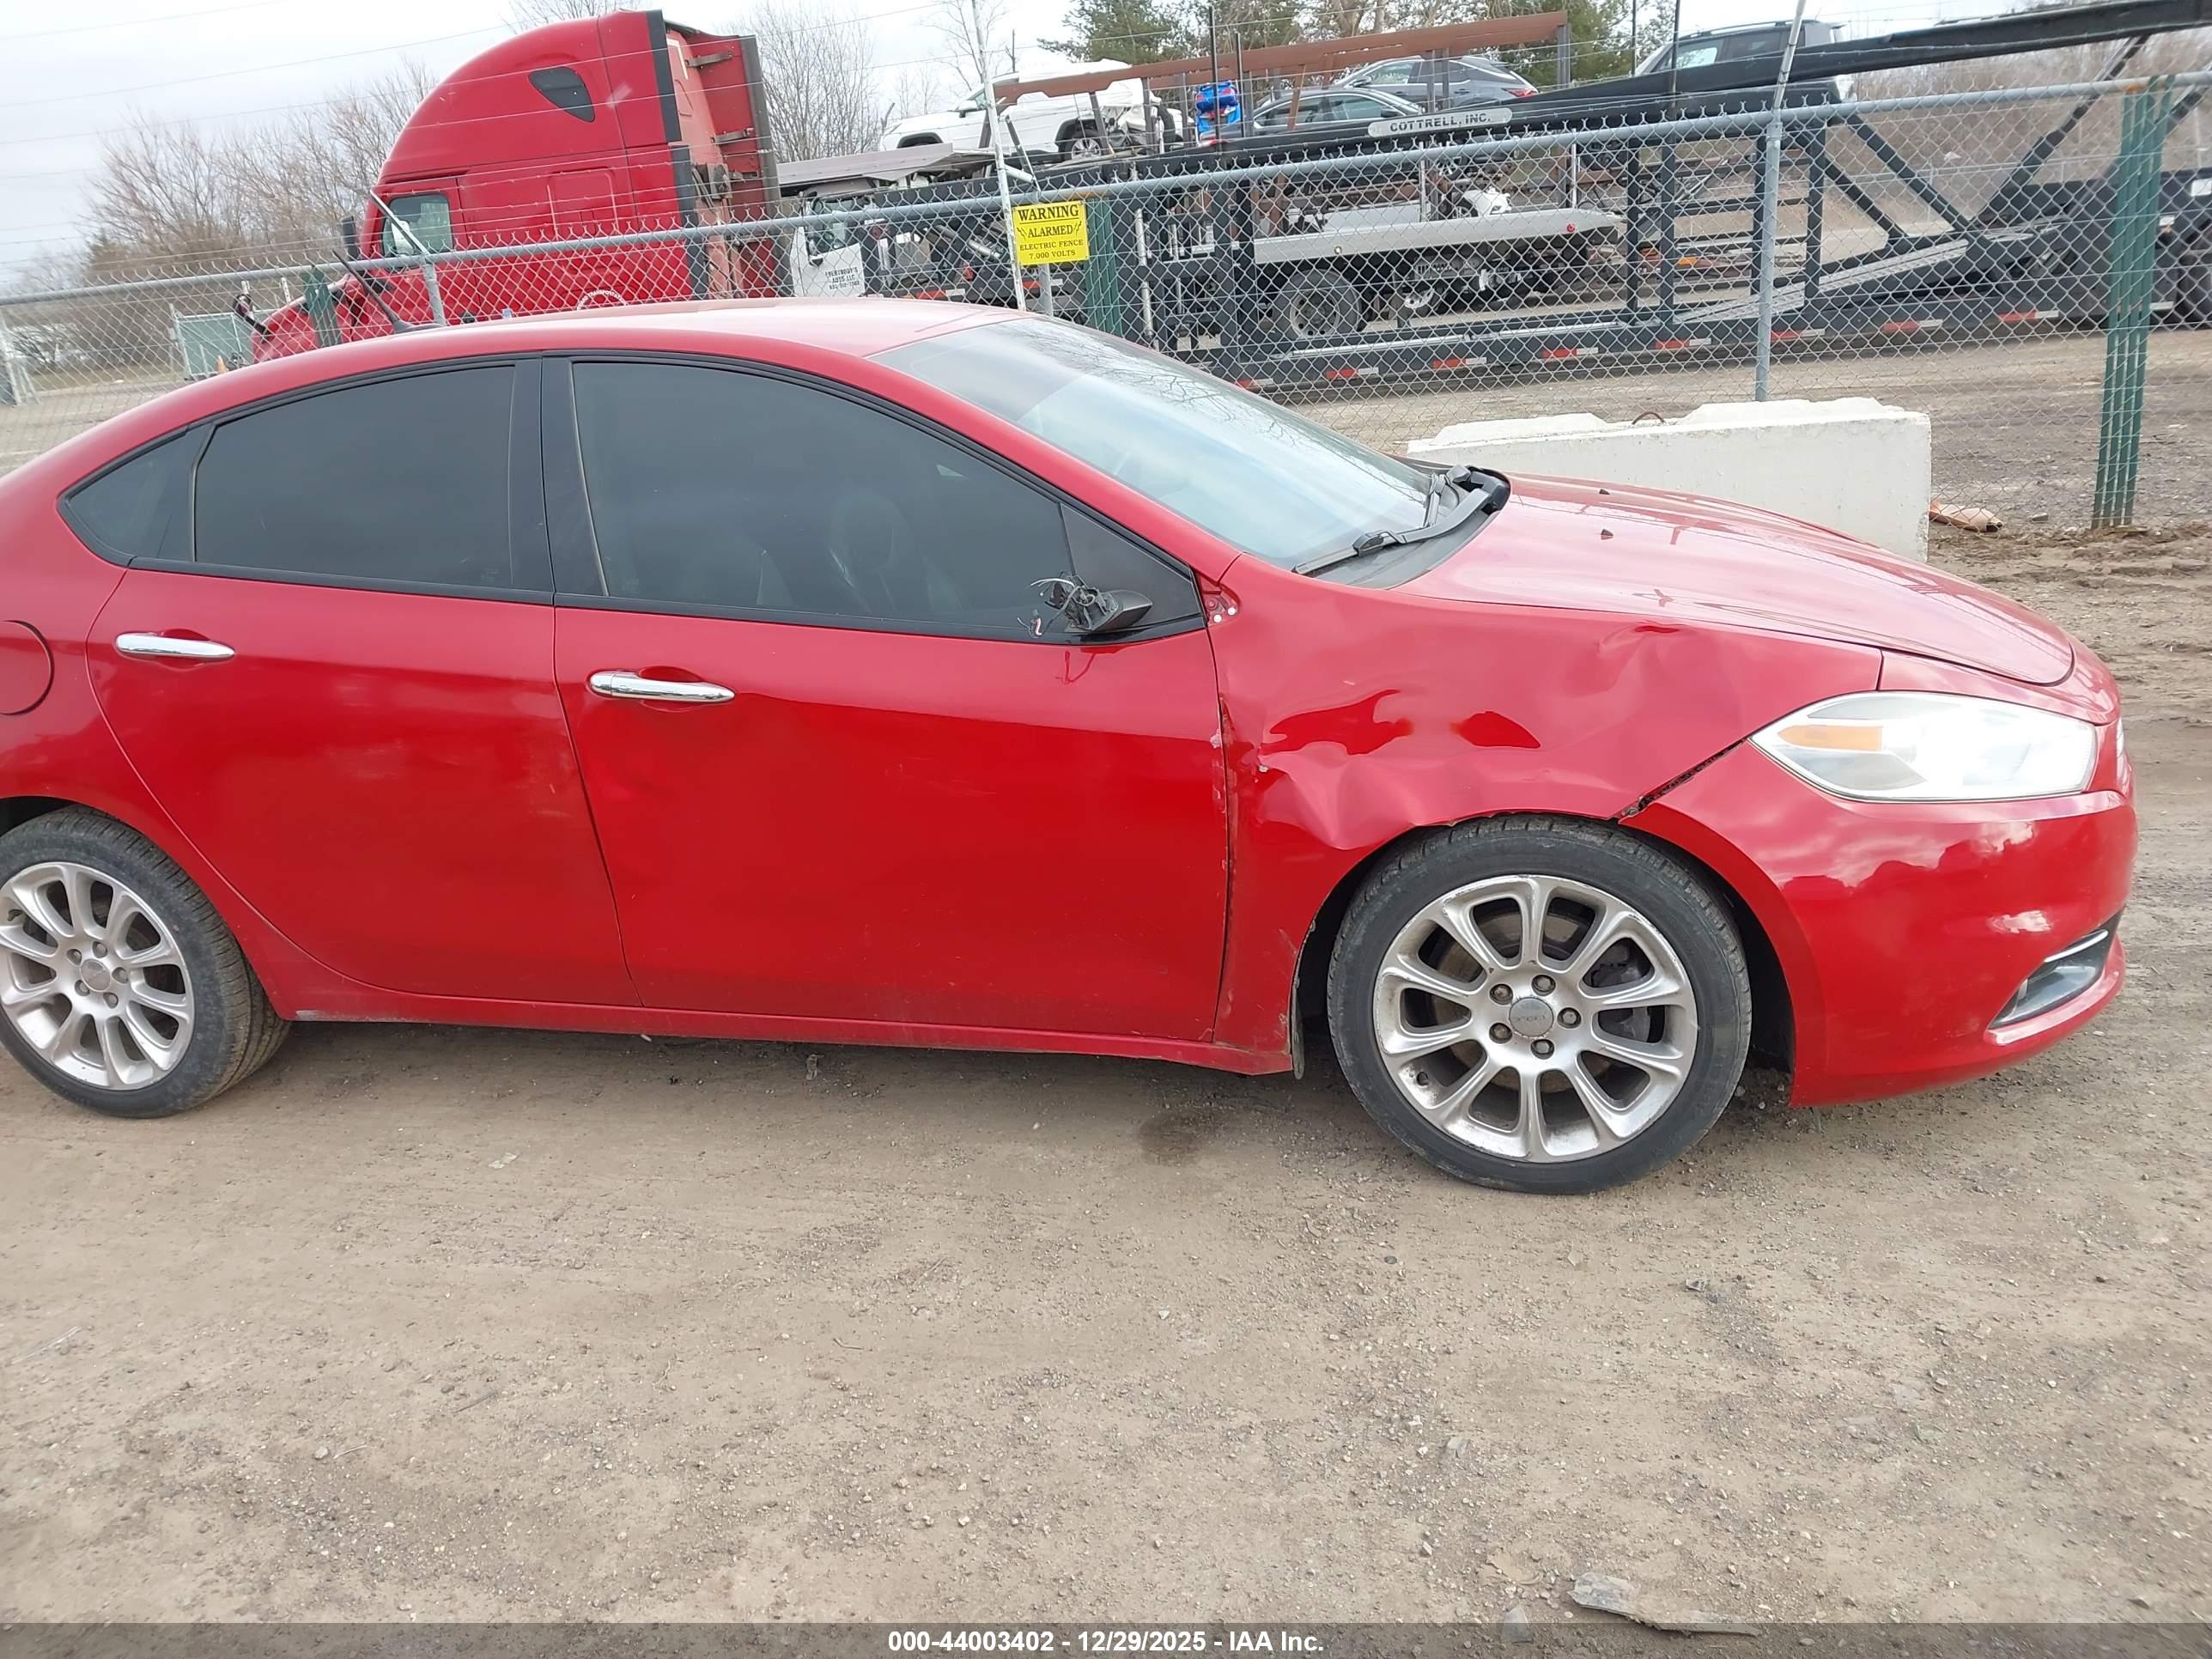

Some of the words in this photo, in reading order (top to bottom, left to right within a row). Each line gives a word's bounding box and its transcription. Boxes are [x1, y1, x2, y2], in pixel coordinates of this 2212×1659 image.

[1018, 204, 1079, 221] WARNING
[1028, 224, 1073, 238] ALARMED
[1019, 241, 1057, 251] ELECTRIC
[1059, 239, 1084, 247] FENCE
[1051, 249, 1076, 258] VOLTS
